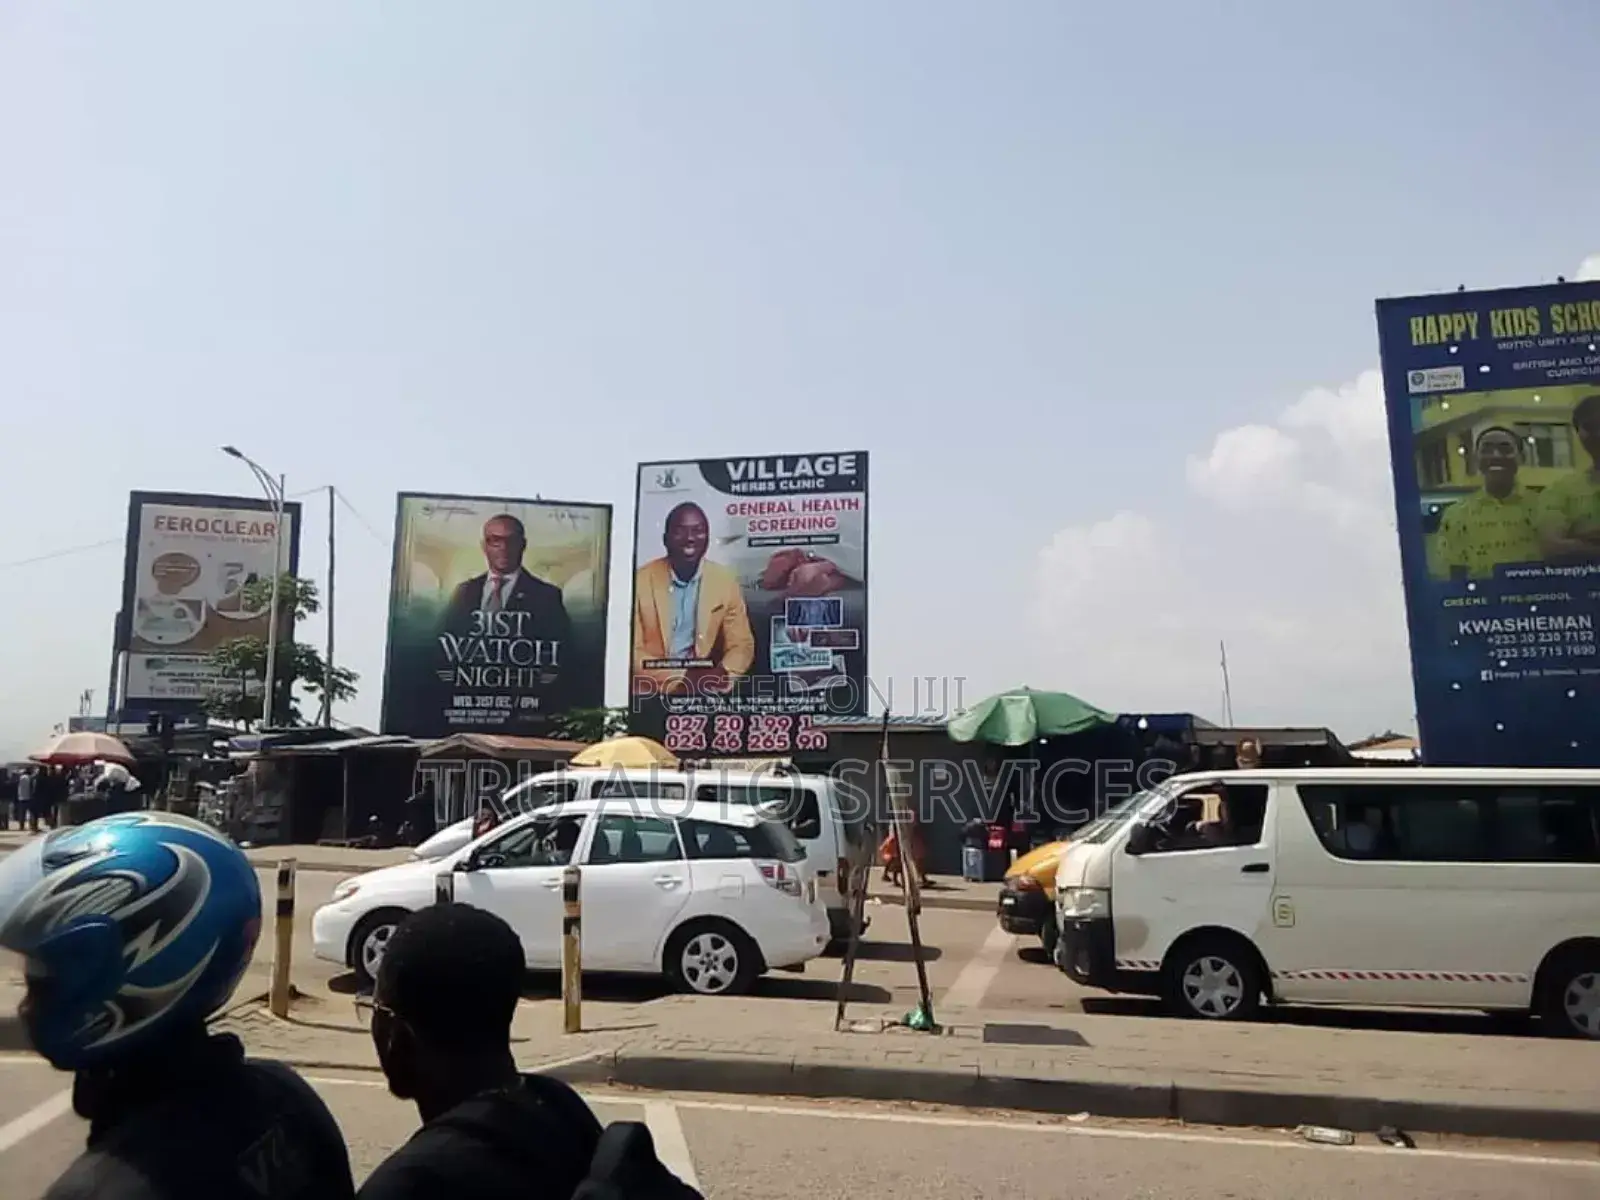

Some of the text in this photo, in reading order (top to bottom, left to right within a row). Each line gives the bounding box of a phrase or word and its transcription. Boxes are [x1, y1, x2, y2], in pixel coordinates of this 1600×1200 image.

[1410, 312, 1478, 345] HAPPY
[1490, 306, 1540, 338] KIDS
[726, 454, 857, 481] VILLAGE
[731, 478, 825, 492] HERBS CLINIC
[726, 498, 859, 515] GENERAL HEALTH
[154, 515, 276, 537] FEROCLEAR
[748, 516, 837, 533] SCREENING
[469, 610, 531, 637] 31ST
[1459, 615, 1592, 635] KWASHIEMAN
[438, 632, 560, 666] WATCH
[455, 666, 540, 688] NIGHT
[667, 715, 708, 733] 027
[714, 715, 744, 733] 20
[750, 715, 792, 733] 199
[666, 731, 828, 751] 024 46 265 90
